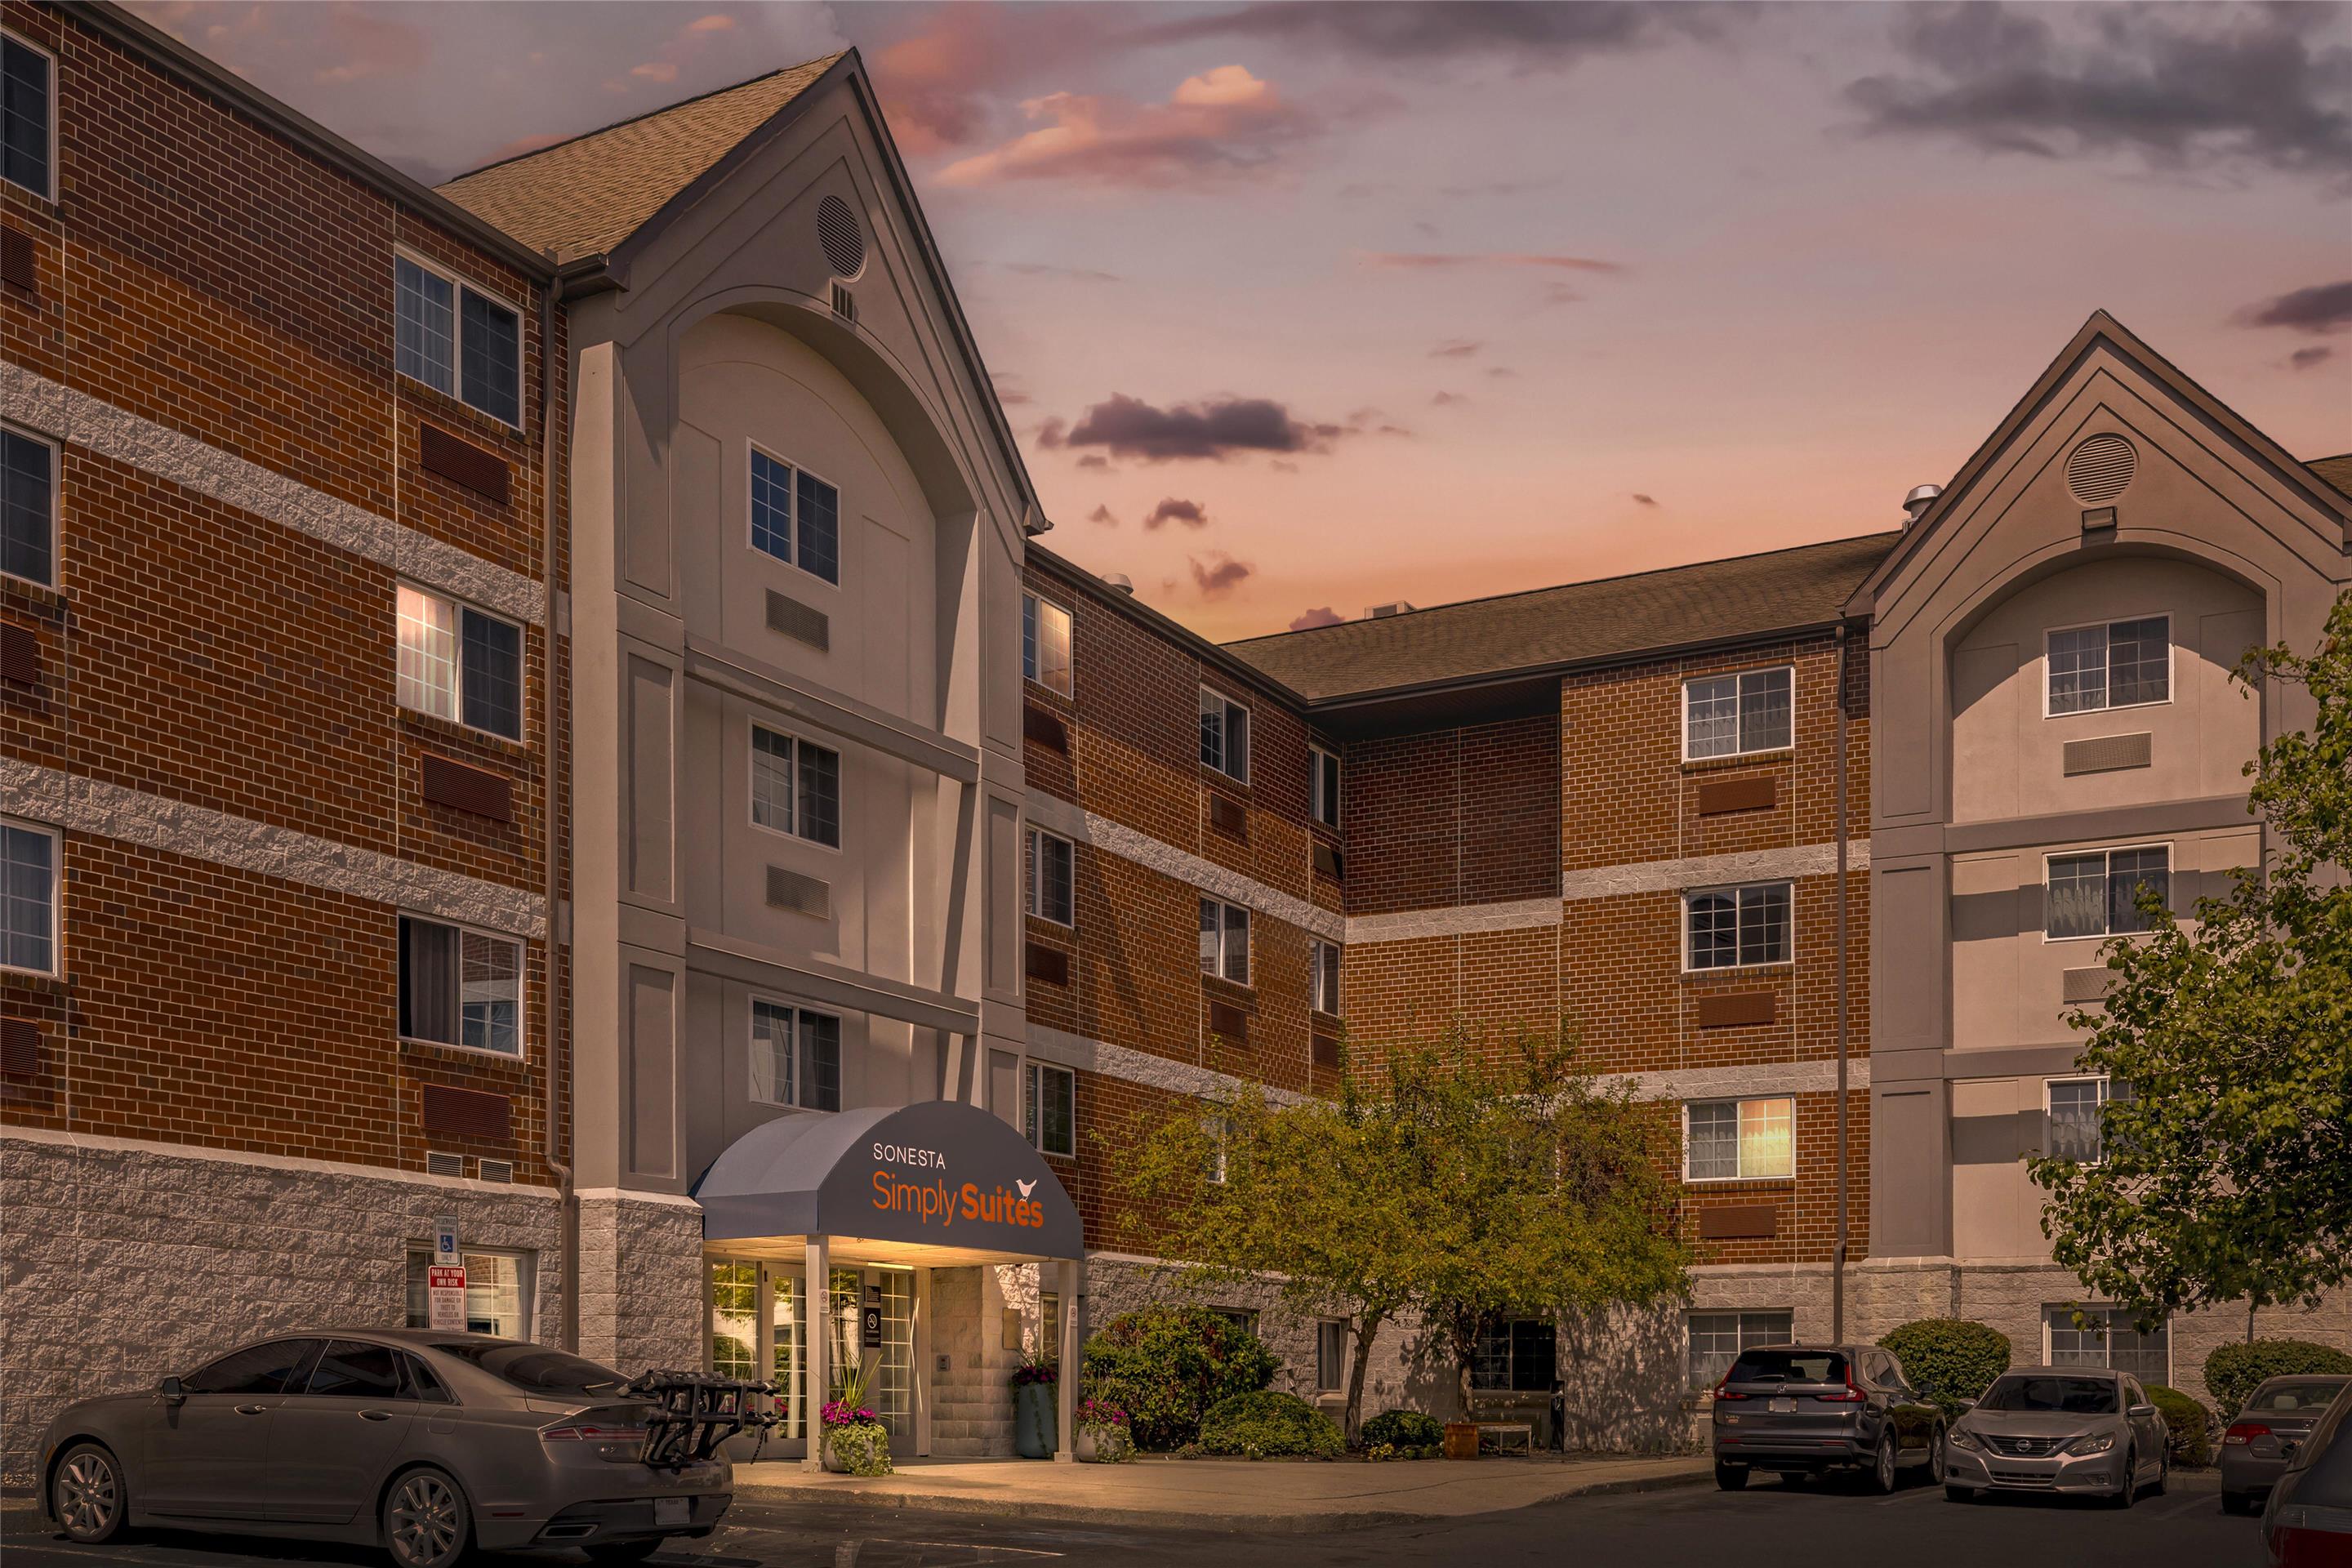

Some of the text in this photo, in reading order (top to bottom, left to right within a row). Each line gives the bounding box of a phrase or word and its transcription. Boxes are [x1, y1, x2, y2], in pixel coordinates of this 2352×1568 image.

[873, 1143, 946, 1170] SONESTA
[872, 1170, 1044, 1228] Simply Suites
[431, 1268, 463, 1278] PARK AT YOUR
[436, 1278, 458, 1286] OWN RISK
